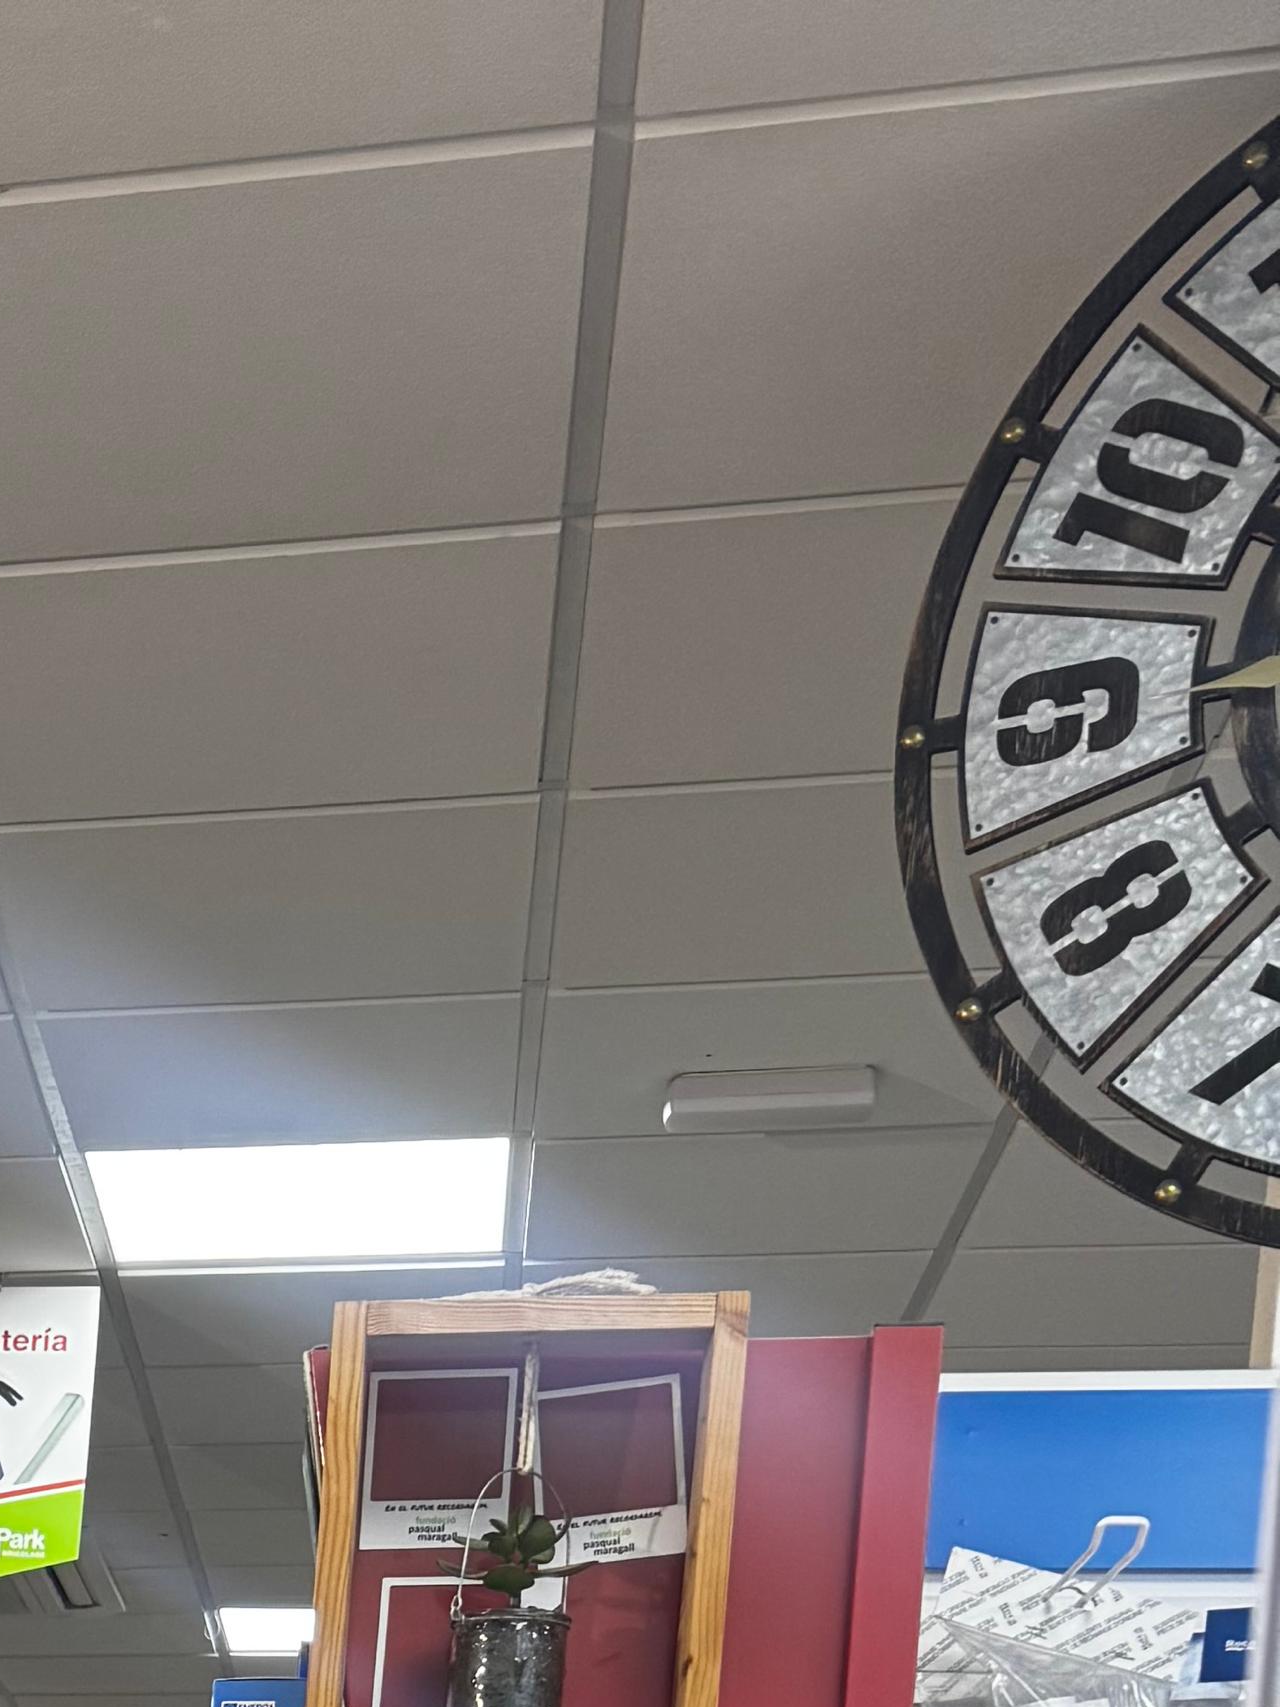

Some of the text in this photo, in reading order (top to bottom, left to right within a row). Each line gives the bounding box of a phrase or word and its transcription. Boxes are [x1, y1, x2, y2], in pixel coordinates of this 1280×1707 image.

[1052, 396, 1243, 563] 10
[996, 655, 1139, 768] 9
[1040, 839, 1192, 977] 8
[408, 1524, 445, 1536] pasqual
[583, 1537, 621, 1551] pasqual
[593, 1543, 635, 1556] maragall
